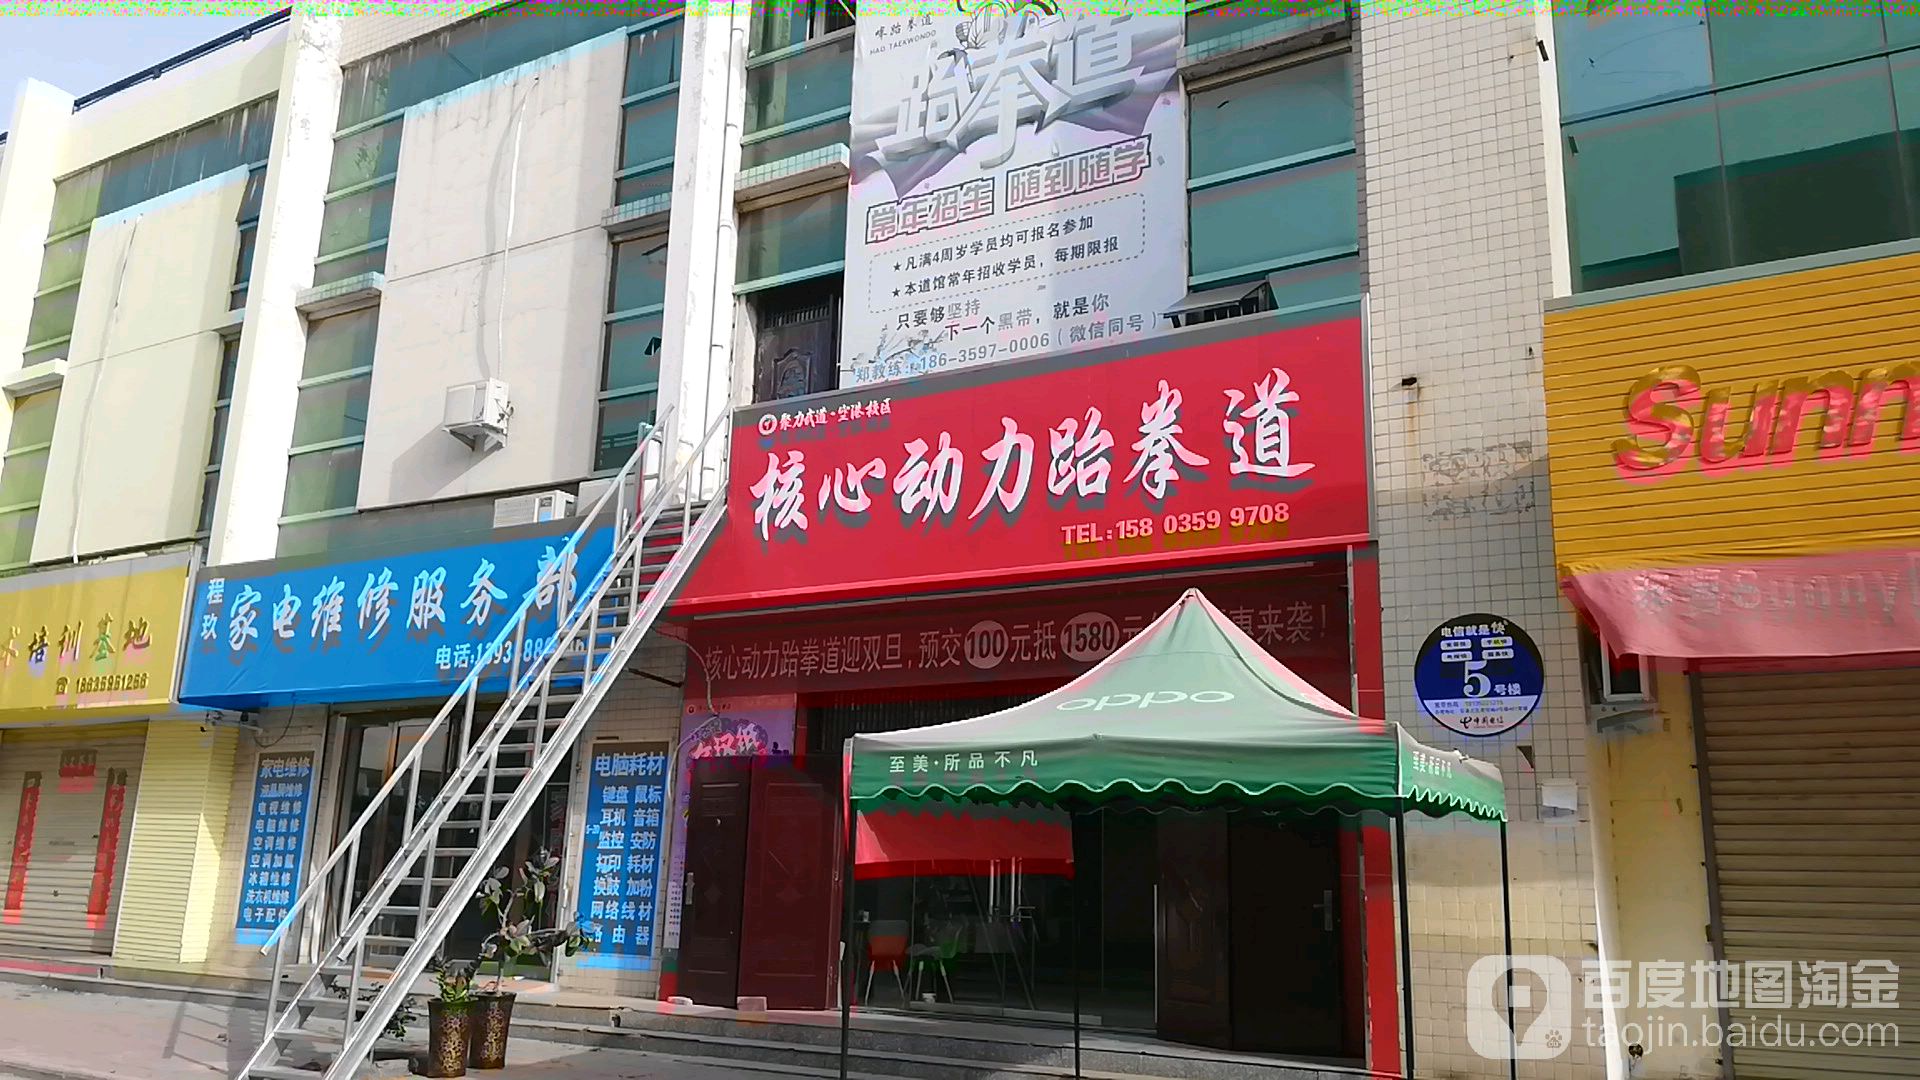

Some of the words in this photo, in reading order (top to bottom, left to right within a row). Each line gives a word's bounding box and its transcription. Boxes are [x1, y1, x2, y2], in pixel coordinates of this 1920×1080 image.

[1009, 138, 1150, 200] 随到随学
[869, 181, 993, 241] 常年招生
[897, 299, 981, 331] 只要够坚持
[750, 368, 1316, 541] 核心动力跆拳道
[1163, 509, 1221, 534] 0359
[1230, 503, 1290, 527] 9708
[227, 536, 580, 651] 家电维修服务部
[260, 757, 311, 778] 家电维修
[595, 752, 665, 777] 电脑耗材
[600, 808, 627, 827] 耳机
[633, 808, 660, 827] 音箱
[630, 831, 656, 850] 安防
[627, 854, 655, 873] 耗材
[590, 901, 653, 921] 网络线材
